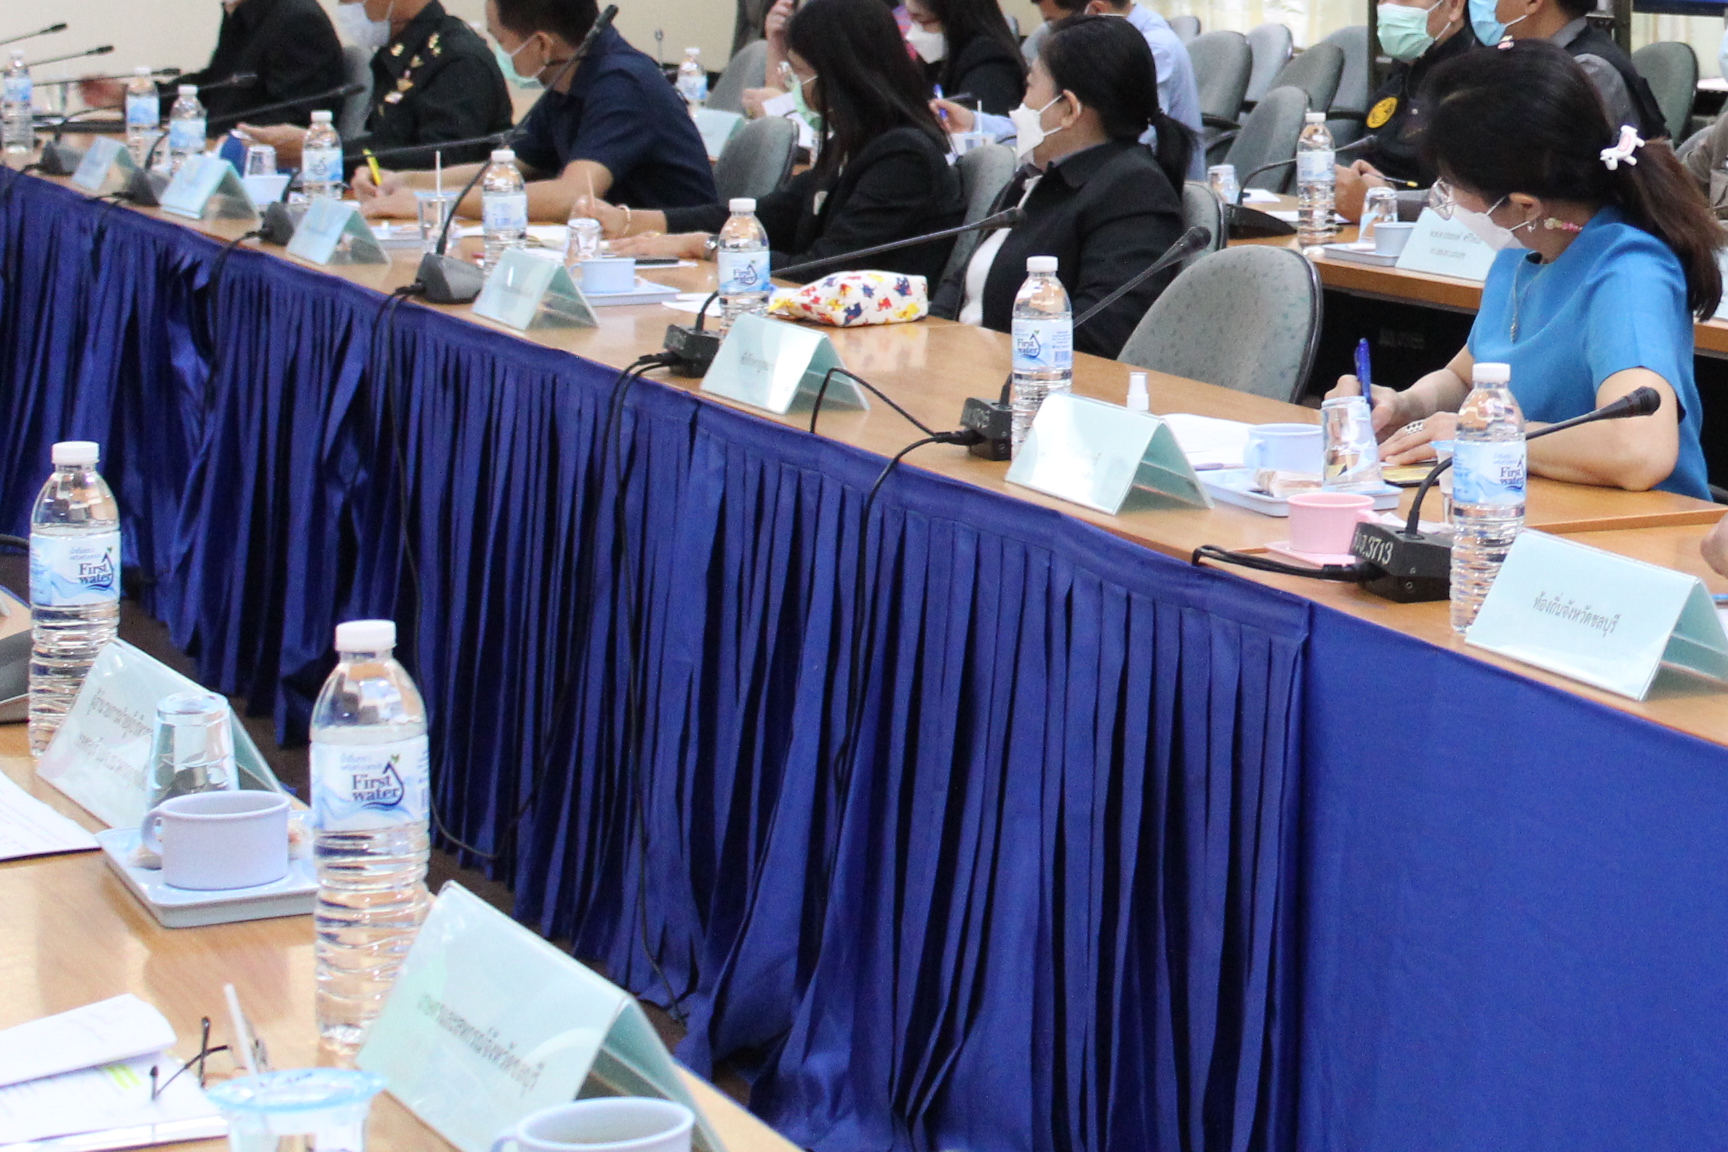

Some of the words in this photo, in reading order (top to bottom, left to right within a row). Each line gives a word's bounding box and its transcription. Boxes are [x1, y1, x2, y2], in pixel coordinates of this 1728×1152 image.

[79, 563, 108, 576] First
[1532, 591, 1621, 638] ท้องถิ่นจังหวัดชลบุรี
[352, 773, 393, 790] First
[351, 787, 400, 802] water
